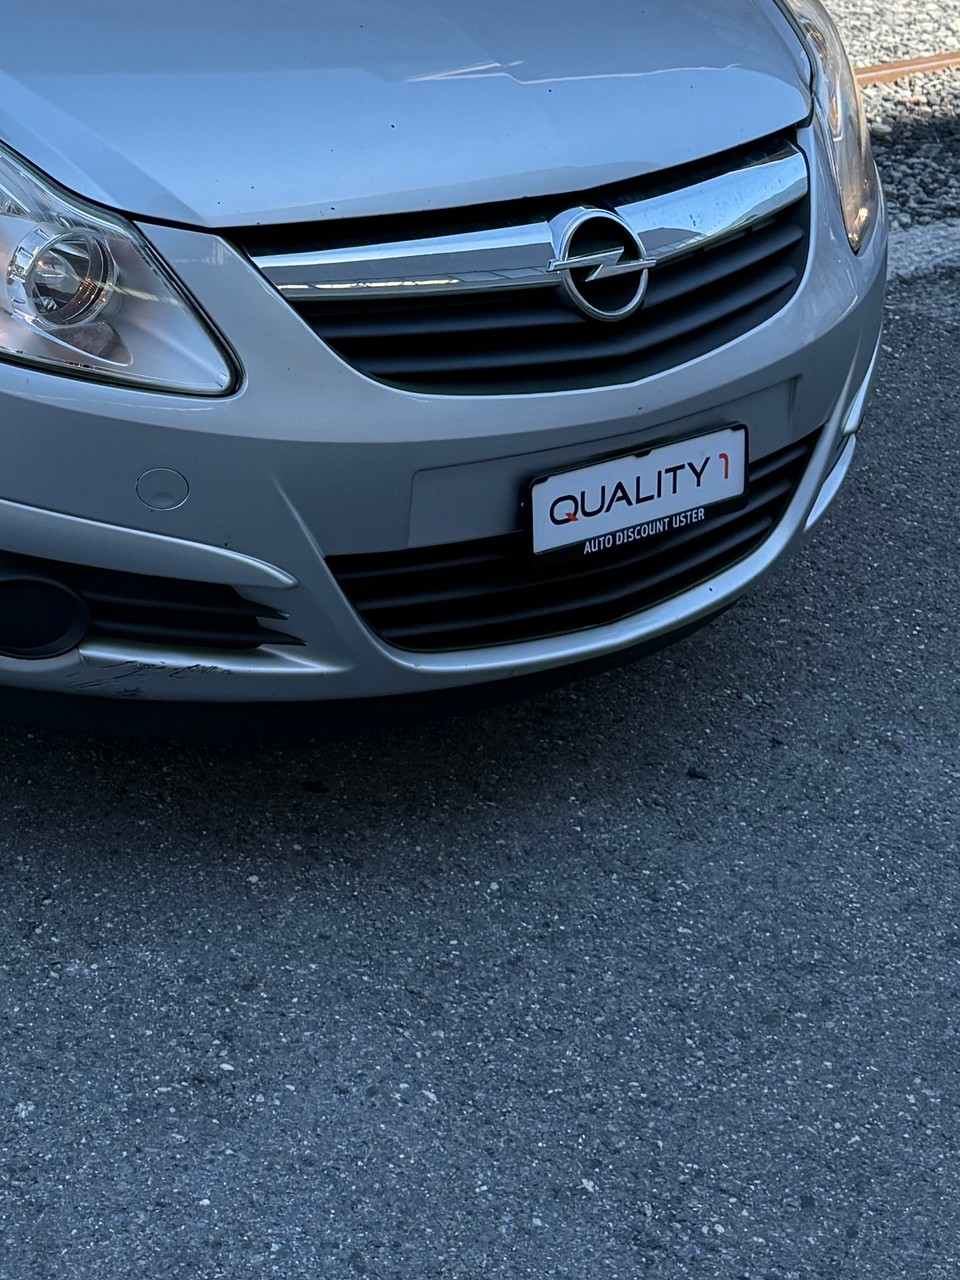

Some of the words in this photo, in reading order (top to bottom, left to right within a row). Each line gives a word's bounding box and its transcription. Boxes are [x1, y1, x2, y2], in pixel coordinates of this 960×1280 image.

[549, 456, 711, 526] QUALITY
[719, 452, 729, 480] 1
[583, 534, 613, 555] AUTO
[615, 519, 669, 546] DISCOUNT
[672, 508, 705, 528] USTER
